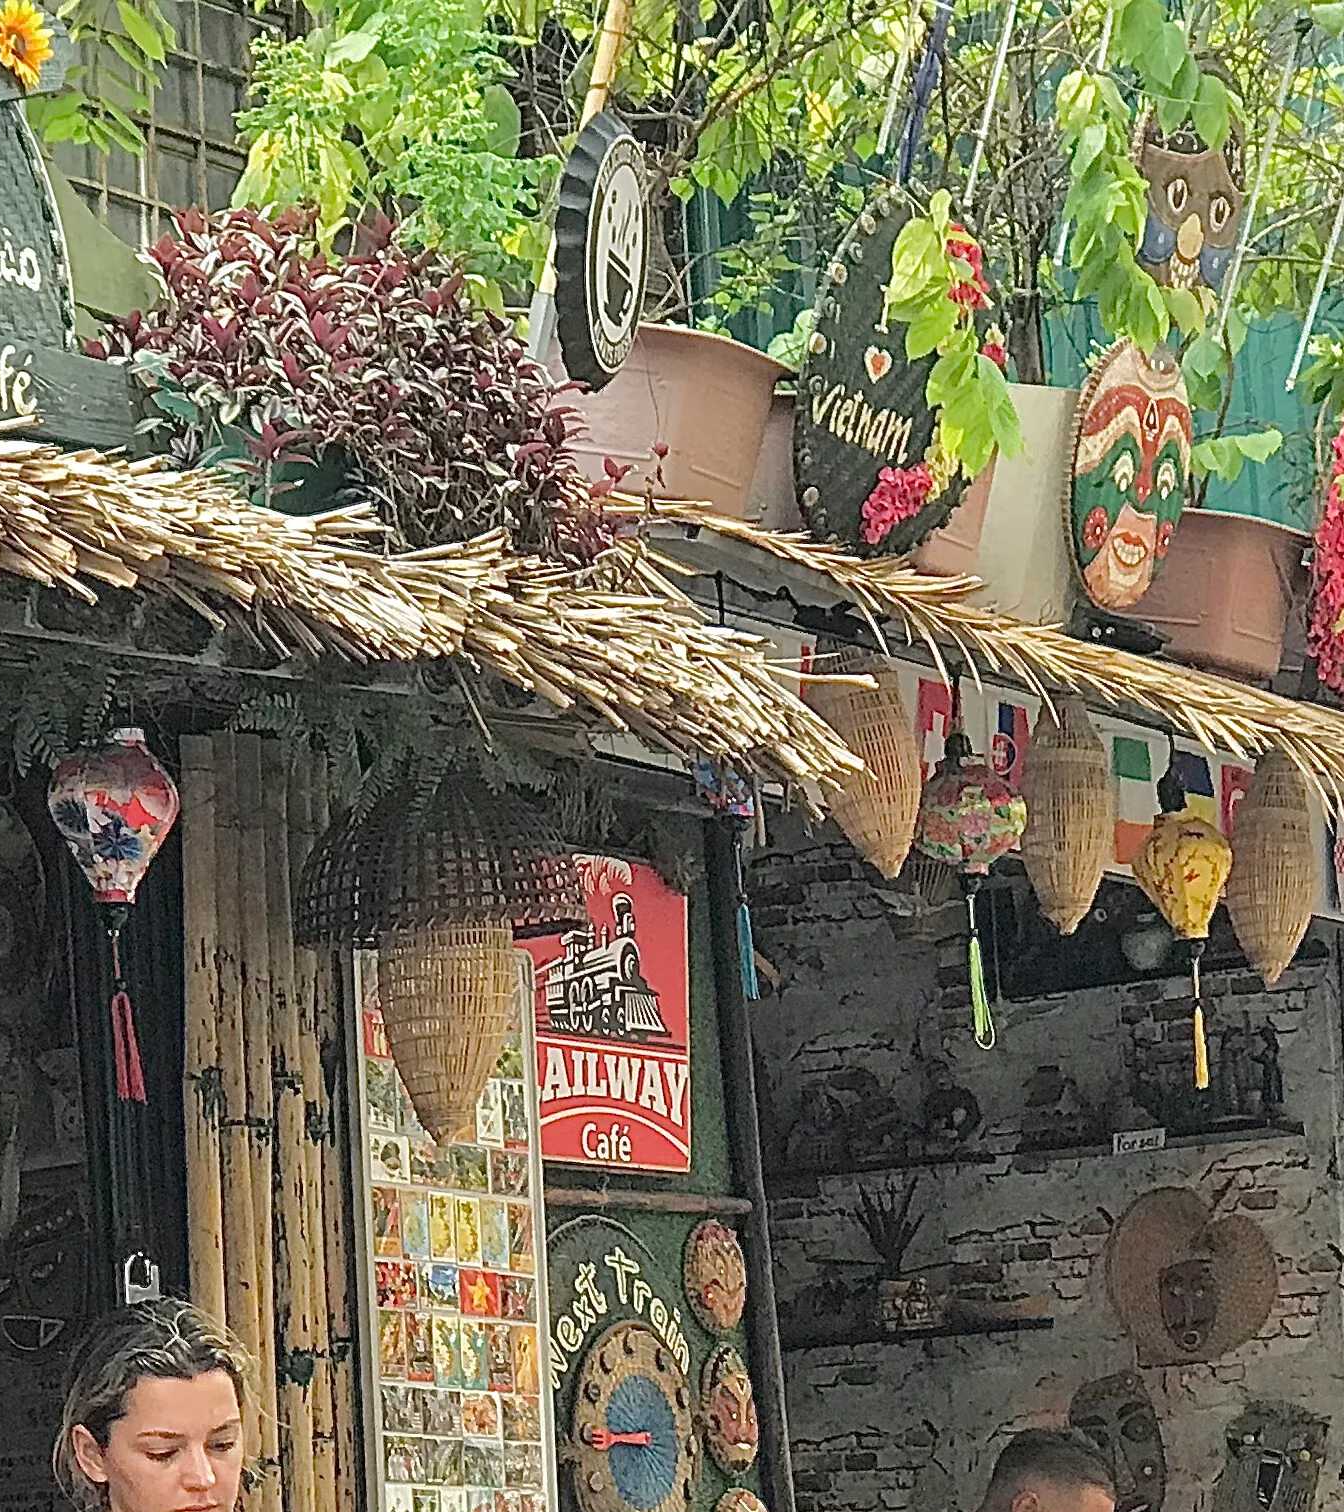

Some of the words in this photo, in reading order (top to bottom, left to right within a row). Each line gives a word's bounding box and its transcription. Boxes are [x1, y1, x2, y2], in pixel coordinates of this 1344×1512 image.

[811, 383, 914, 465] Vietnam
[540, 1046, 690, 1128] AILWAY
[582, 1123, 633, 1163] Café
